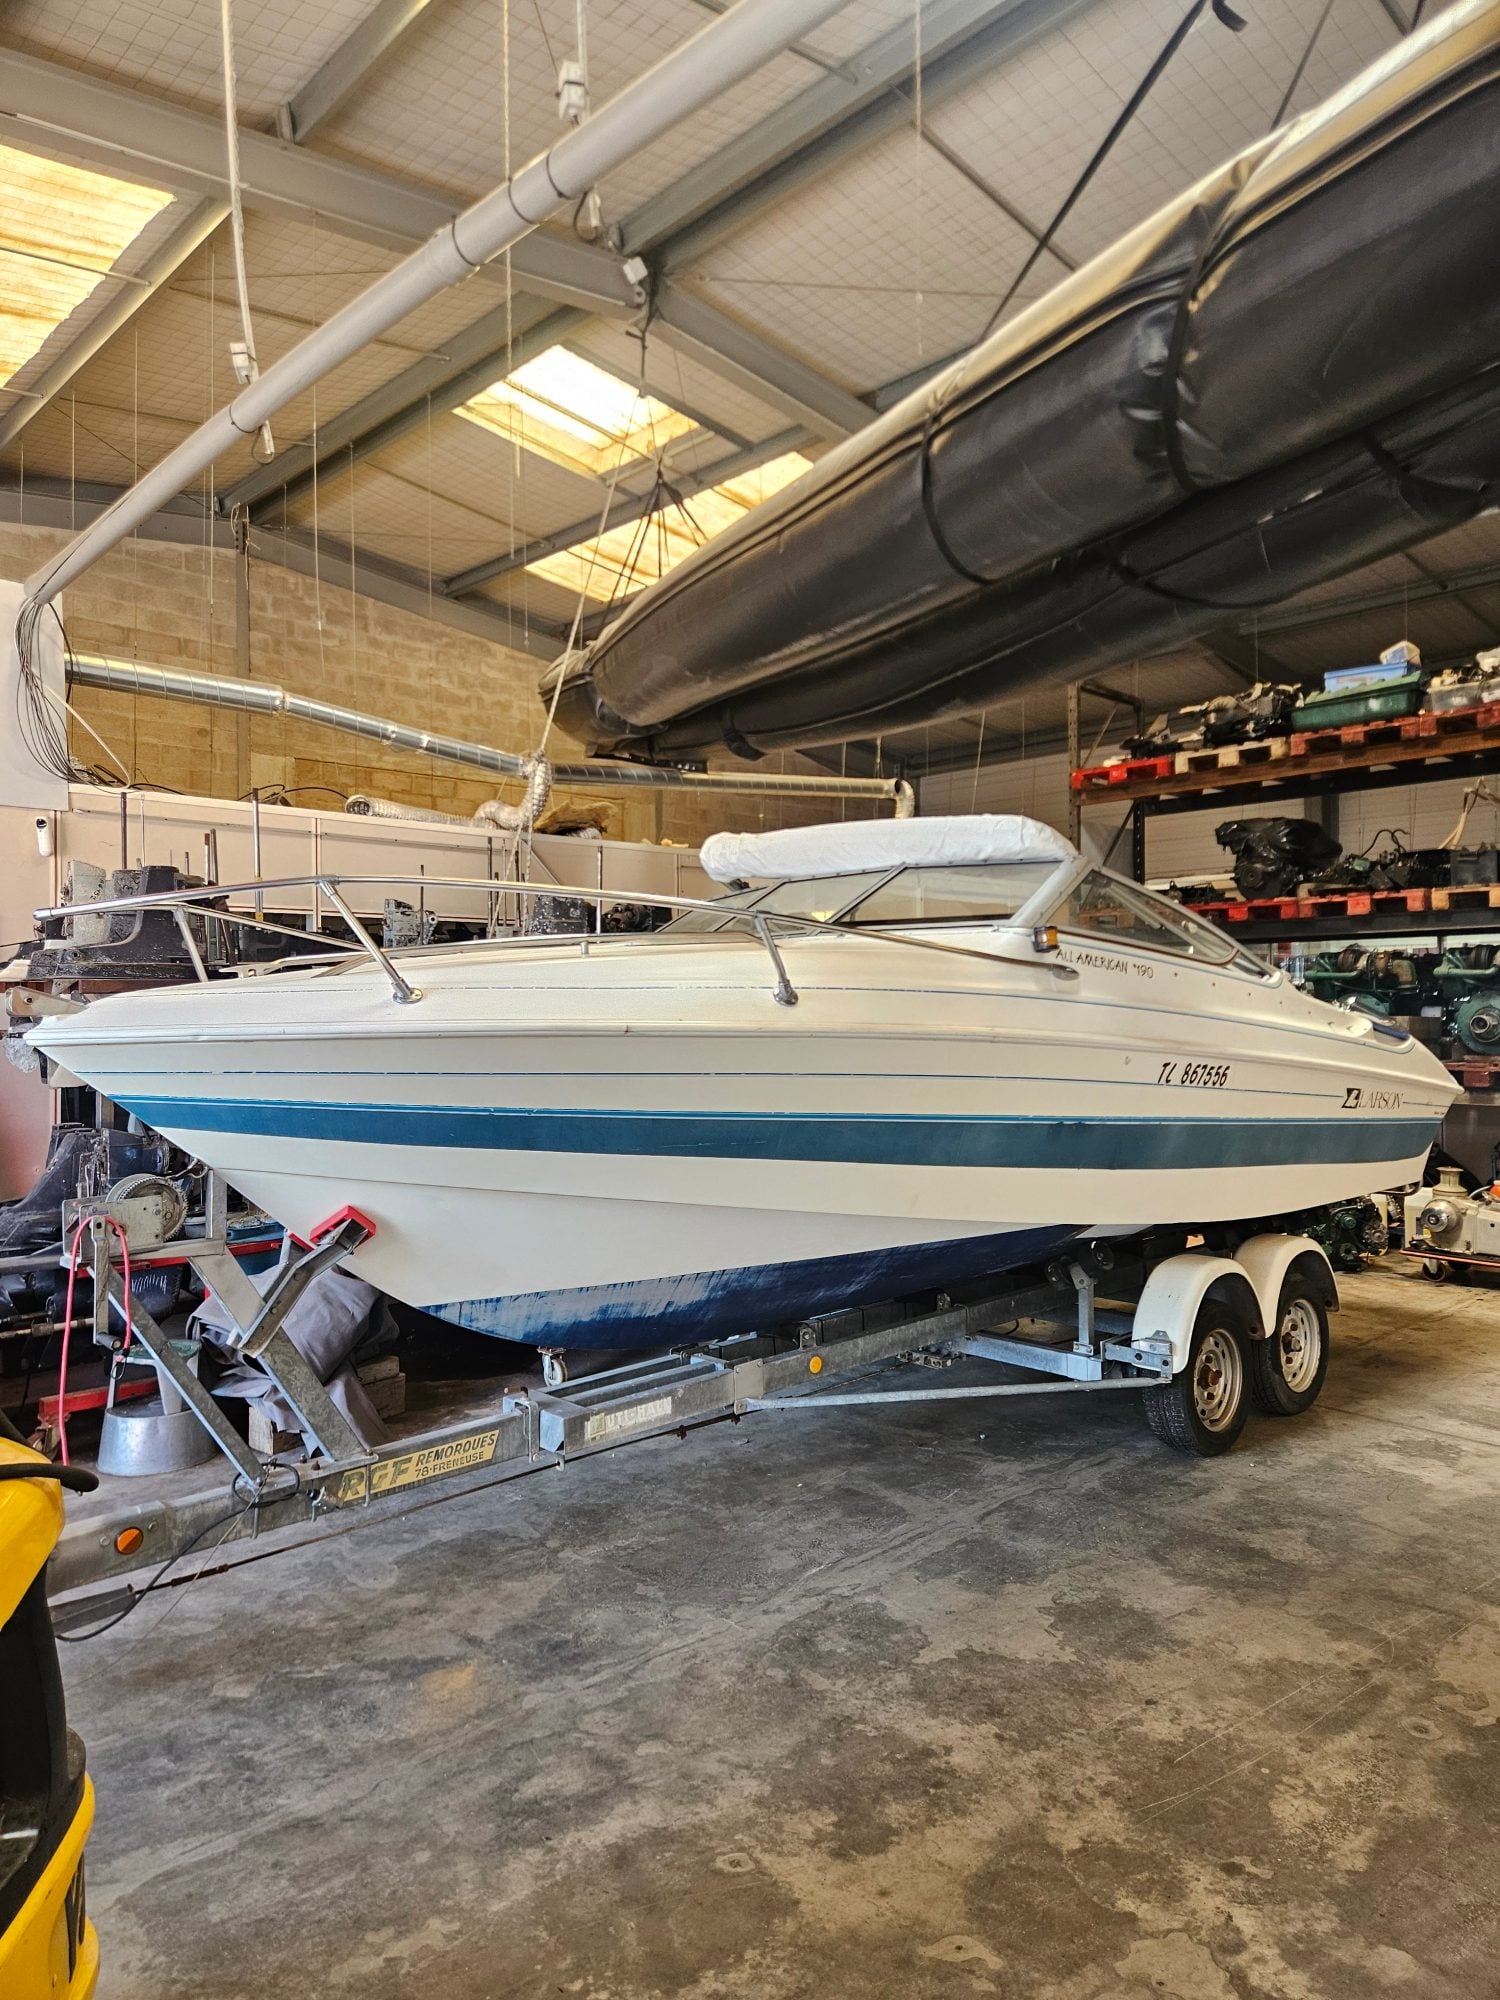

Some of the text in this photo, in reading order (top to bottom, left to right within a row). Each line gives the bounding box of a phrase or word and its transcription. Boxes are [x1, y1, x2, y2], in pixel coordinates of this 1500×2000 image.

[1056, 949, 1073, 963] ALL
[1076, 953, 1128, 975] AMERICAN
[1158, 1062, 1231, 1087] TL 867556
[1359, 1090, 1404, 1110] LARSON
[416, 1433, 496, 1467] REMORQUES
